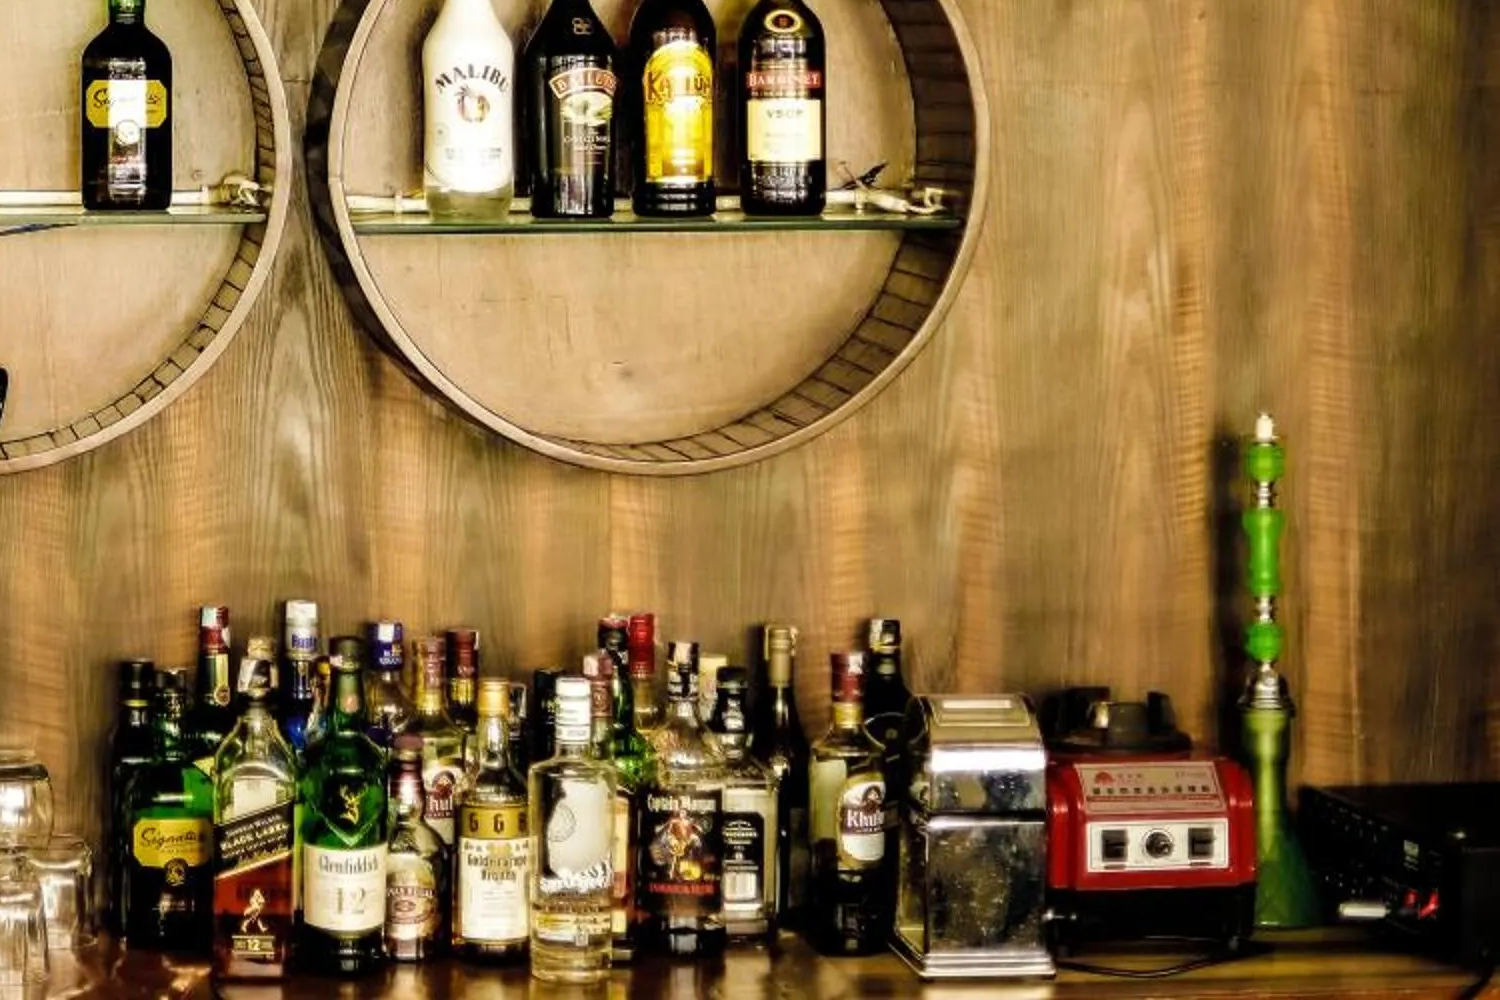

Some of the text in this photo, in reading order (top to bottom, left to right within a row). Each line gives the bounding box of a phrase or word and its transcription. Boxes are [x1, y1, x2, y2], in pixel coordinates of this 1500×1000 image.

[435, 63, 510, 94] MALIBU
[337, 886, 365, 914] 12
[247, 939, 261, 951] 12
